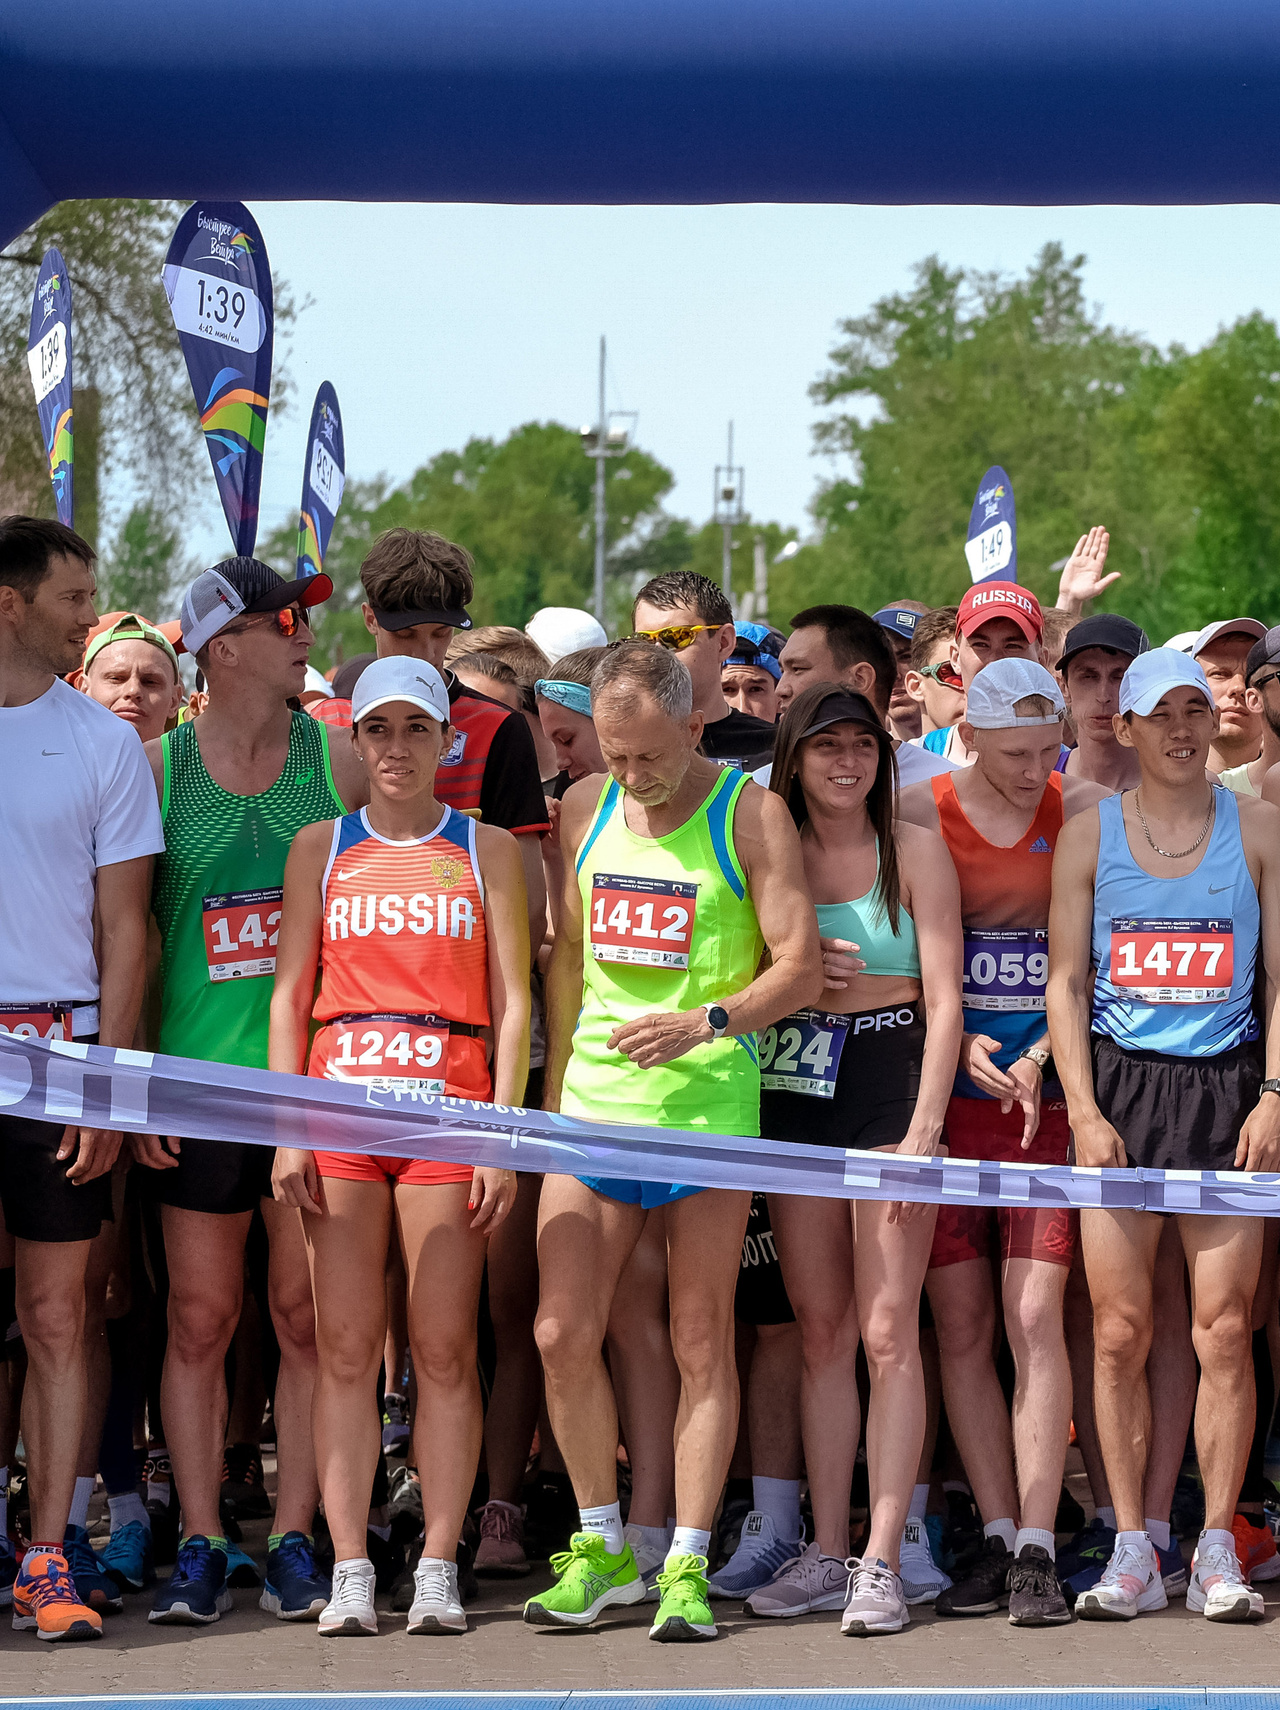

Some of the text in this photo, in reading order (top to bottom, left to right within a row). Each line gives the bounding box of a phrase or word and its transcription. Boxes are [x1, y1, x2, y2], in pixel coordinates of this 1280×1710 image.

[197, 210, 232, 241] Быстрее
[198, 279, 246, 329] 1:39
[198, 323, 213, 335] 4:42
[981, 528, 1004, 564] 1:49
[972, 589, 1033, 615] RUSSIA
[327, 893, 477, 941] RUSSIA
[592, 898, 689, 942] 1412
[963, 952, 1049, 987] 059
[1117, 941, 1225, 976] 1477
[853, 1008, 914, 1035] PRO
[334, 1030, 443, 1068] 1249
[759, 1027, 834, 1075] 924
